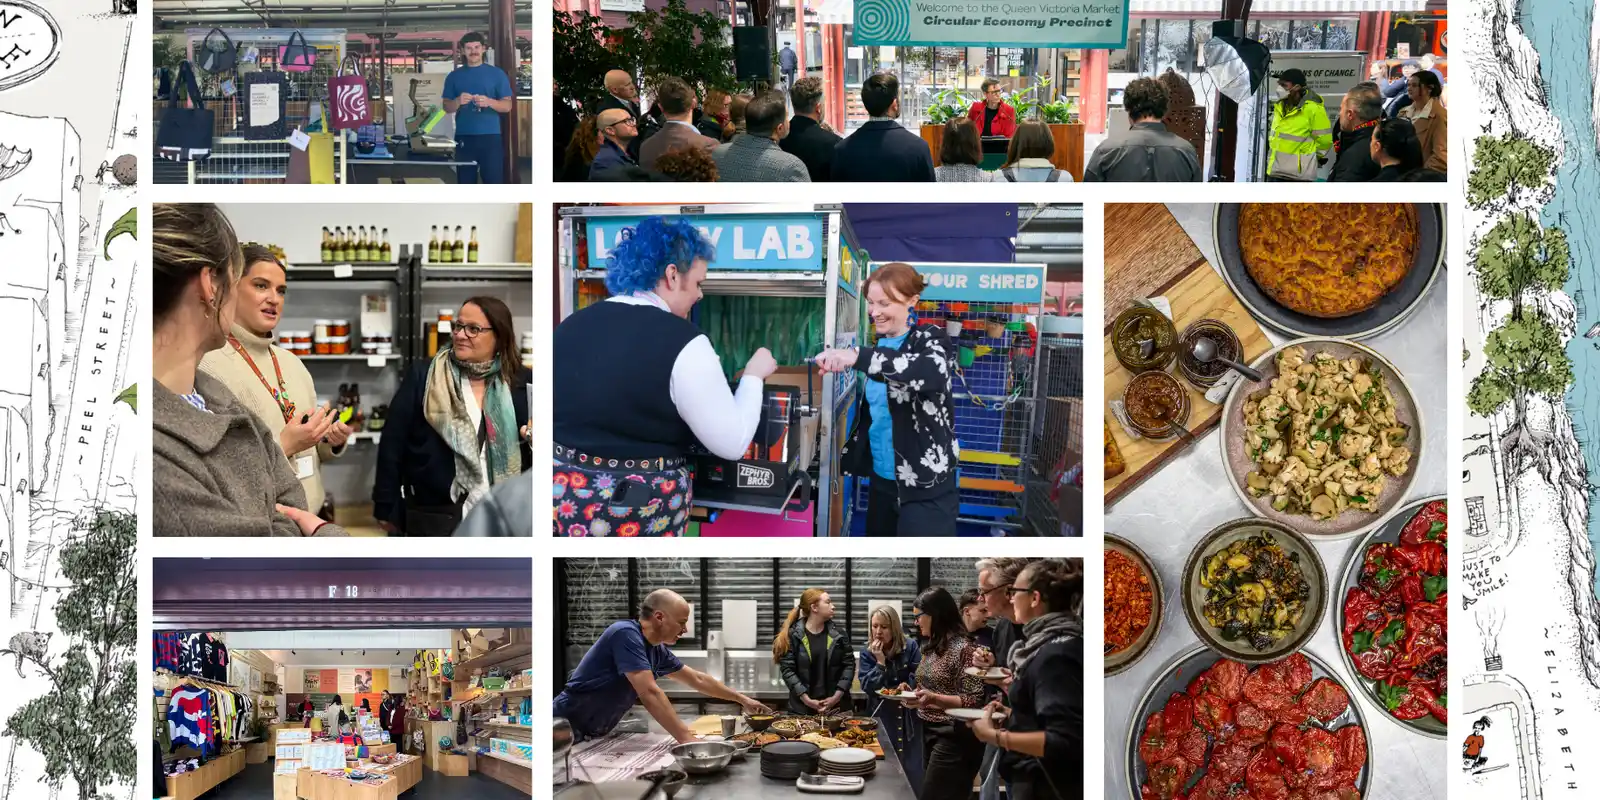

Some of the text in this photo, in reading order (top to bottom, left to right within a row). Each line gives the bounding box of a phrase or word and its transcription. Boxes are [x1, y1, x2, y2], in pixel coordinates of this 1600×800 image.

[916, 3, 1120, 15] Welcome to the Queen Victoria Market
[923, 15, 1113, 29] Circular Economy Precinct
[1313, 69, 1323, 77] OF
[1324, 69, 1356, 77] CHANGE.
[733, 225, 814, 259] LAB
[979, 274, 1038, 289] SHRED
[78, 297, 116, 445] PEEL STREET
[740, 466, 770, 479] ZEPHYR
[747, 476, 770, 486] BROS.
[1462, 556, 1501, 571] JUST TO
[1462, 568, 1490, 582] MAKE
[1468, 577, 1493, 591] YOU
[1475, 573, 1509, 597] SMILE!
[328, 585, 358, 598] F 18
